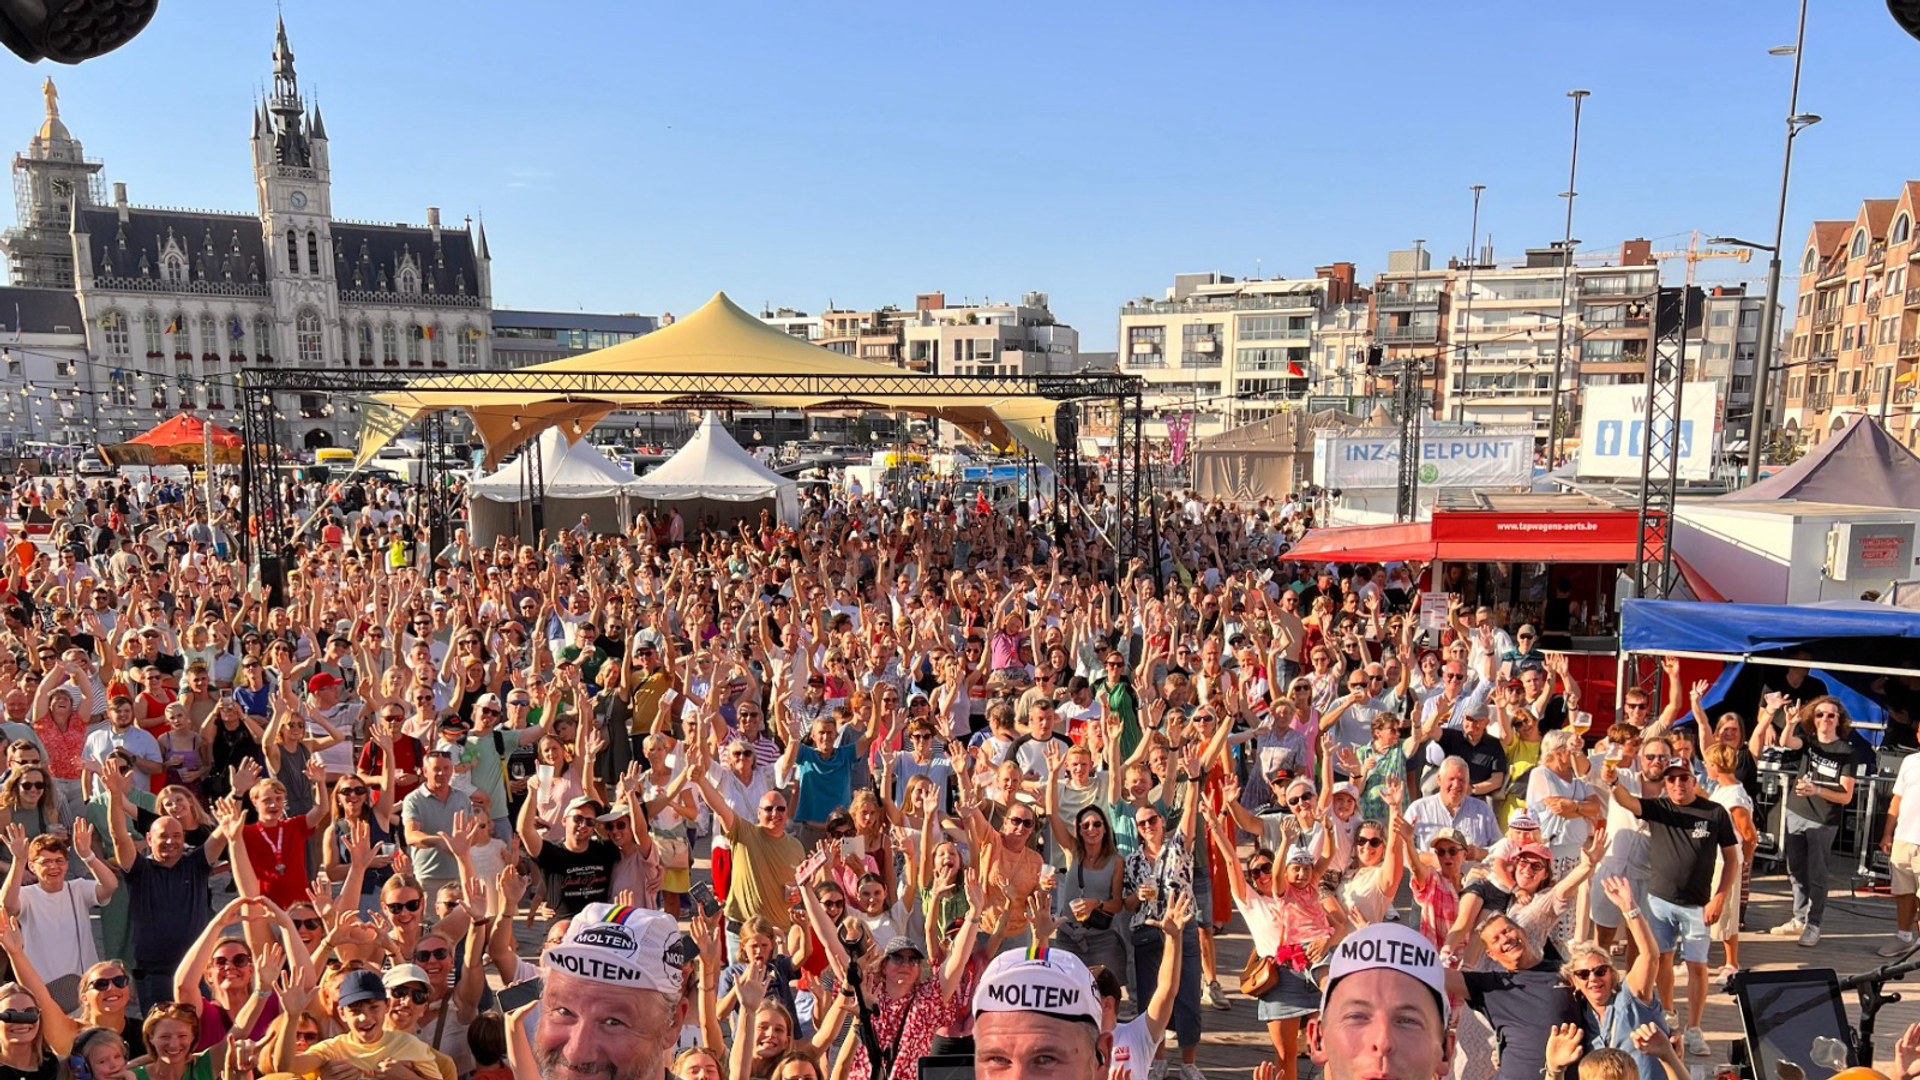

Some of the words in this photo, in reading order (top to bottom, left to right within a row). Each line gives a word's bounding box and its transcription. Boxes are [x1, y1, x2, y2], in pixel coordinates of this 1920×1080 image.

[1346, 442, 1513, 461] INZAELPUNT
[1497, 522, 1598, 532] www.tapwagens-aerts.be
[576, 933, 636, 950] MOLTENI
[1341, 939, 1436, 967] MOLTENI
[549, 952, 641, 980] MOLTENI
[988, 984, 1079, 1008] MOLTENI
